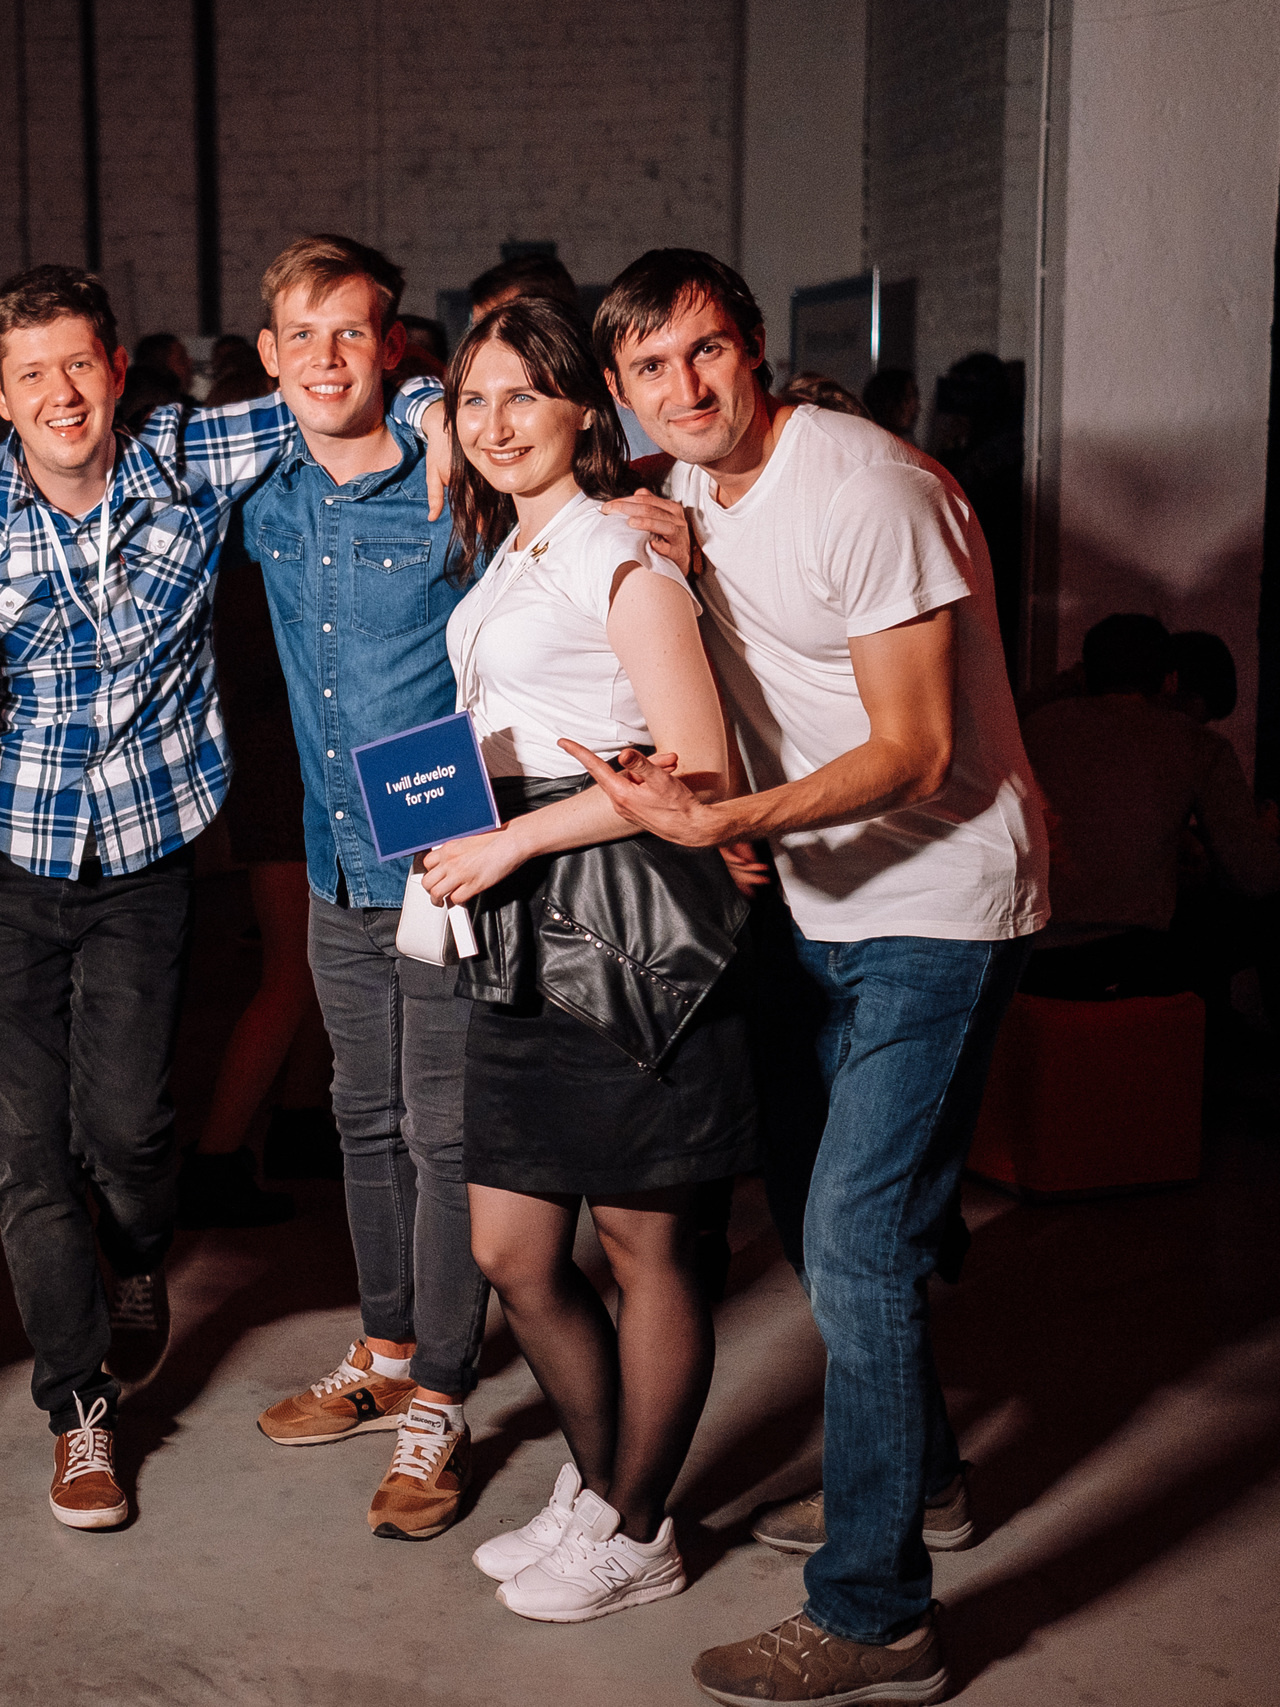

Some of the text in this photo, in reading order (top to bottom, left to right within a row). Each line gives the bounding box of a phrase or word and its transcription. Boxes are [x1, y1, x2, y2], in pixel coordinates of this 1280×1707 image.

[385, 765, 456, 795] I will develop
[405, 786, 445, 806] for you
[590, 1556, 631, 1591] N
